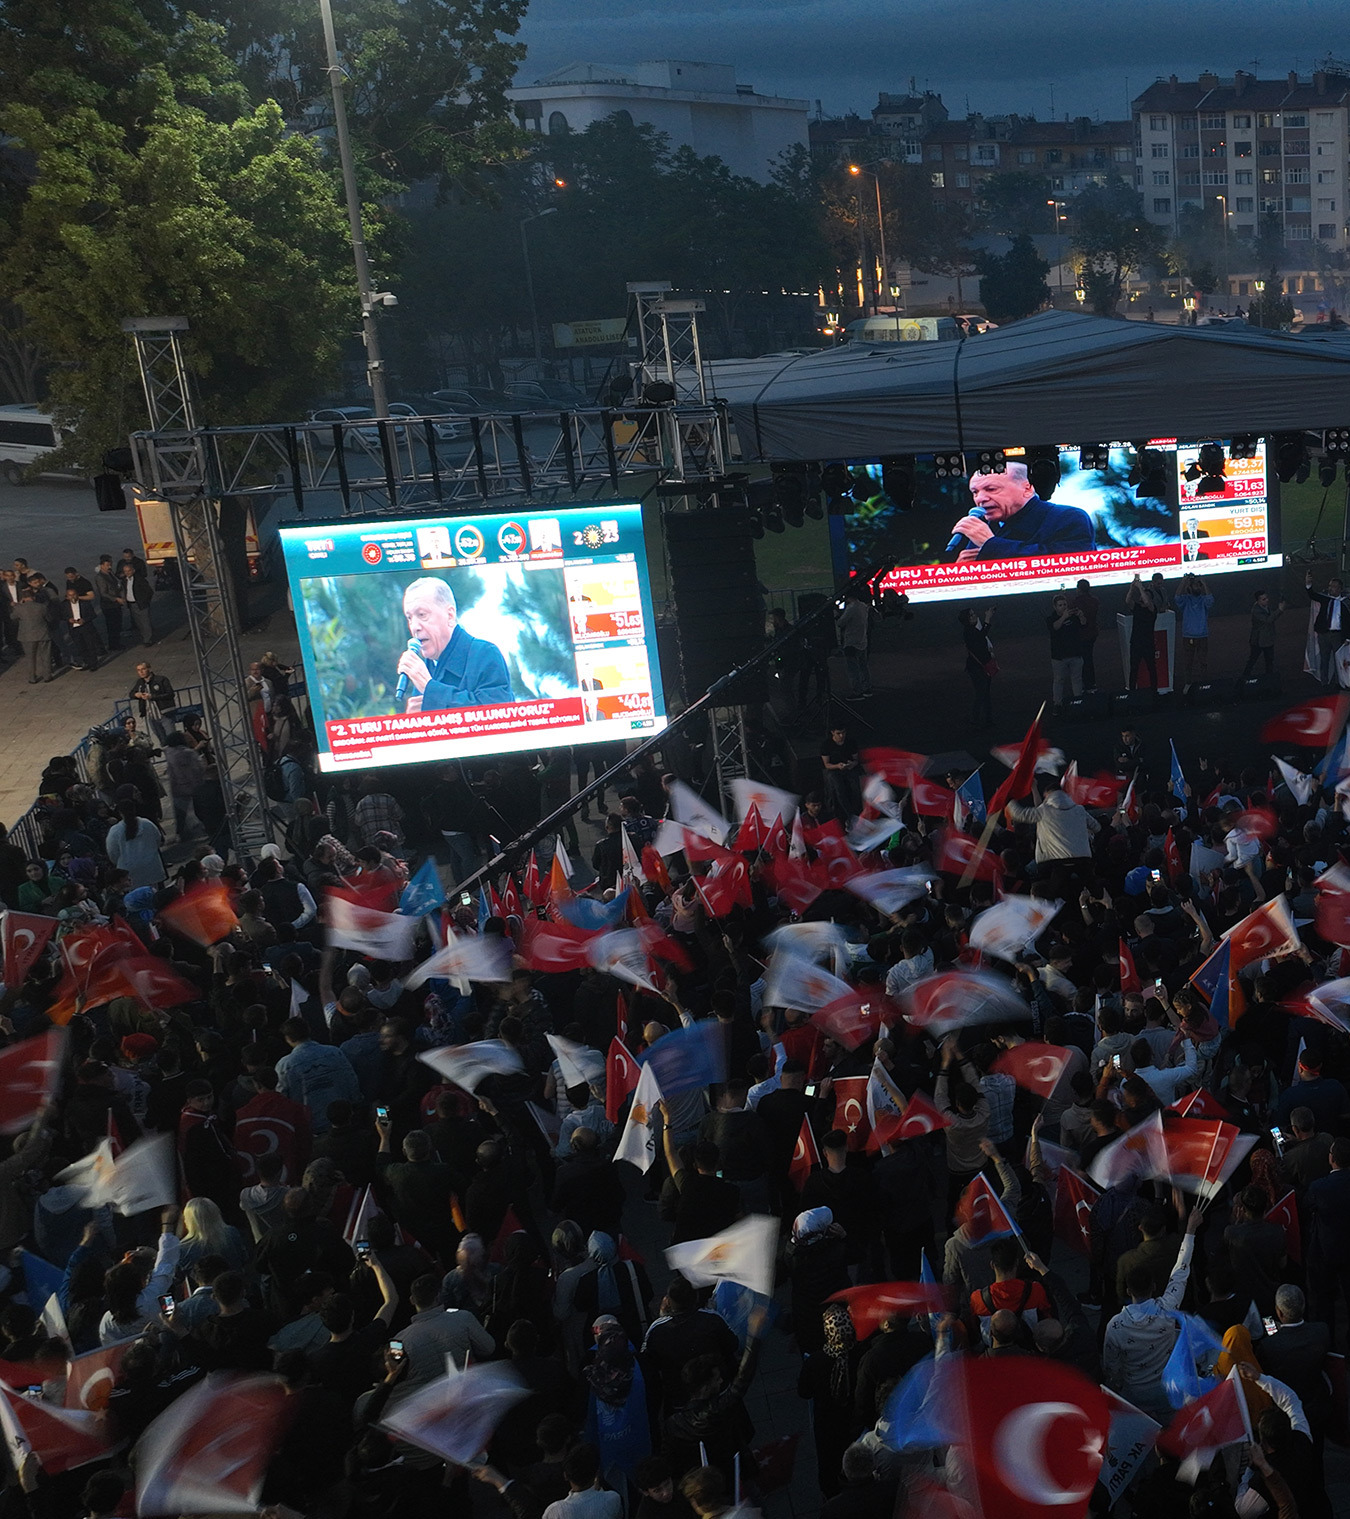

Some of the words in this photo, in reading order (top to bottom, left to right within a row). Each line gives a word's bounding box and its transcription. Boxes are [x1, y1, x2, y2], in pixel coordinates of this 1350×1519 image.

[1230, 527, 1264, 535] ERDOĞAN
[888, 568, 921, 580] URU
[924, 560, 1028, 576] TAMAMLAMIŞ
[912, 577, 937, 586] PARTİ
[937, 575, 979, 584] DAVASINA
[980, 572, 1007, 580] GÖNÜL
[1036, 567, 1054, 575] TÜM
[1137, 556, 1176, 565] EDİYORUM
[348, 720, 382, 735] TURU
[382, 712, 463, 731] TAMAMLAMIŞ
